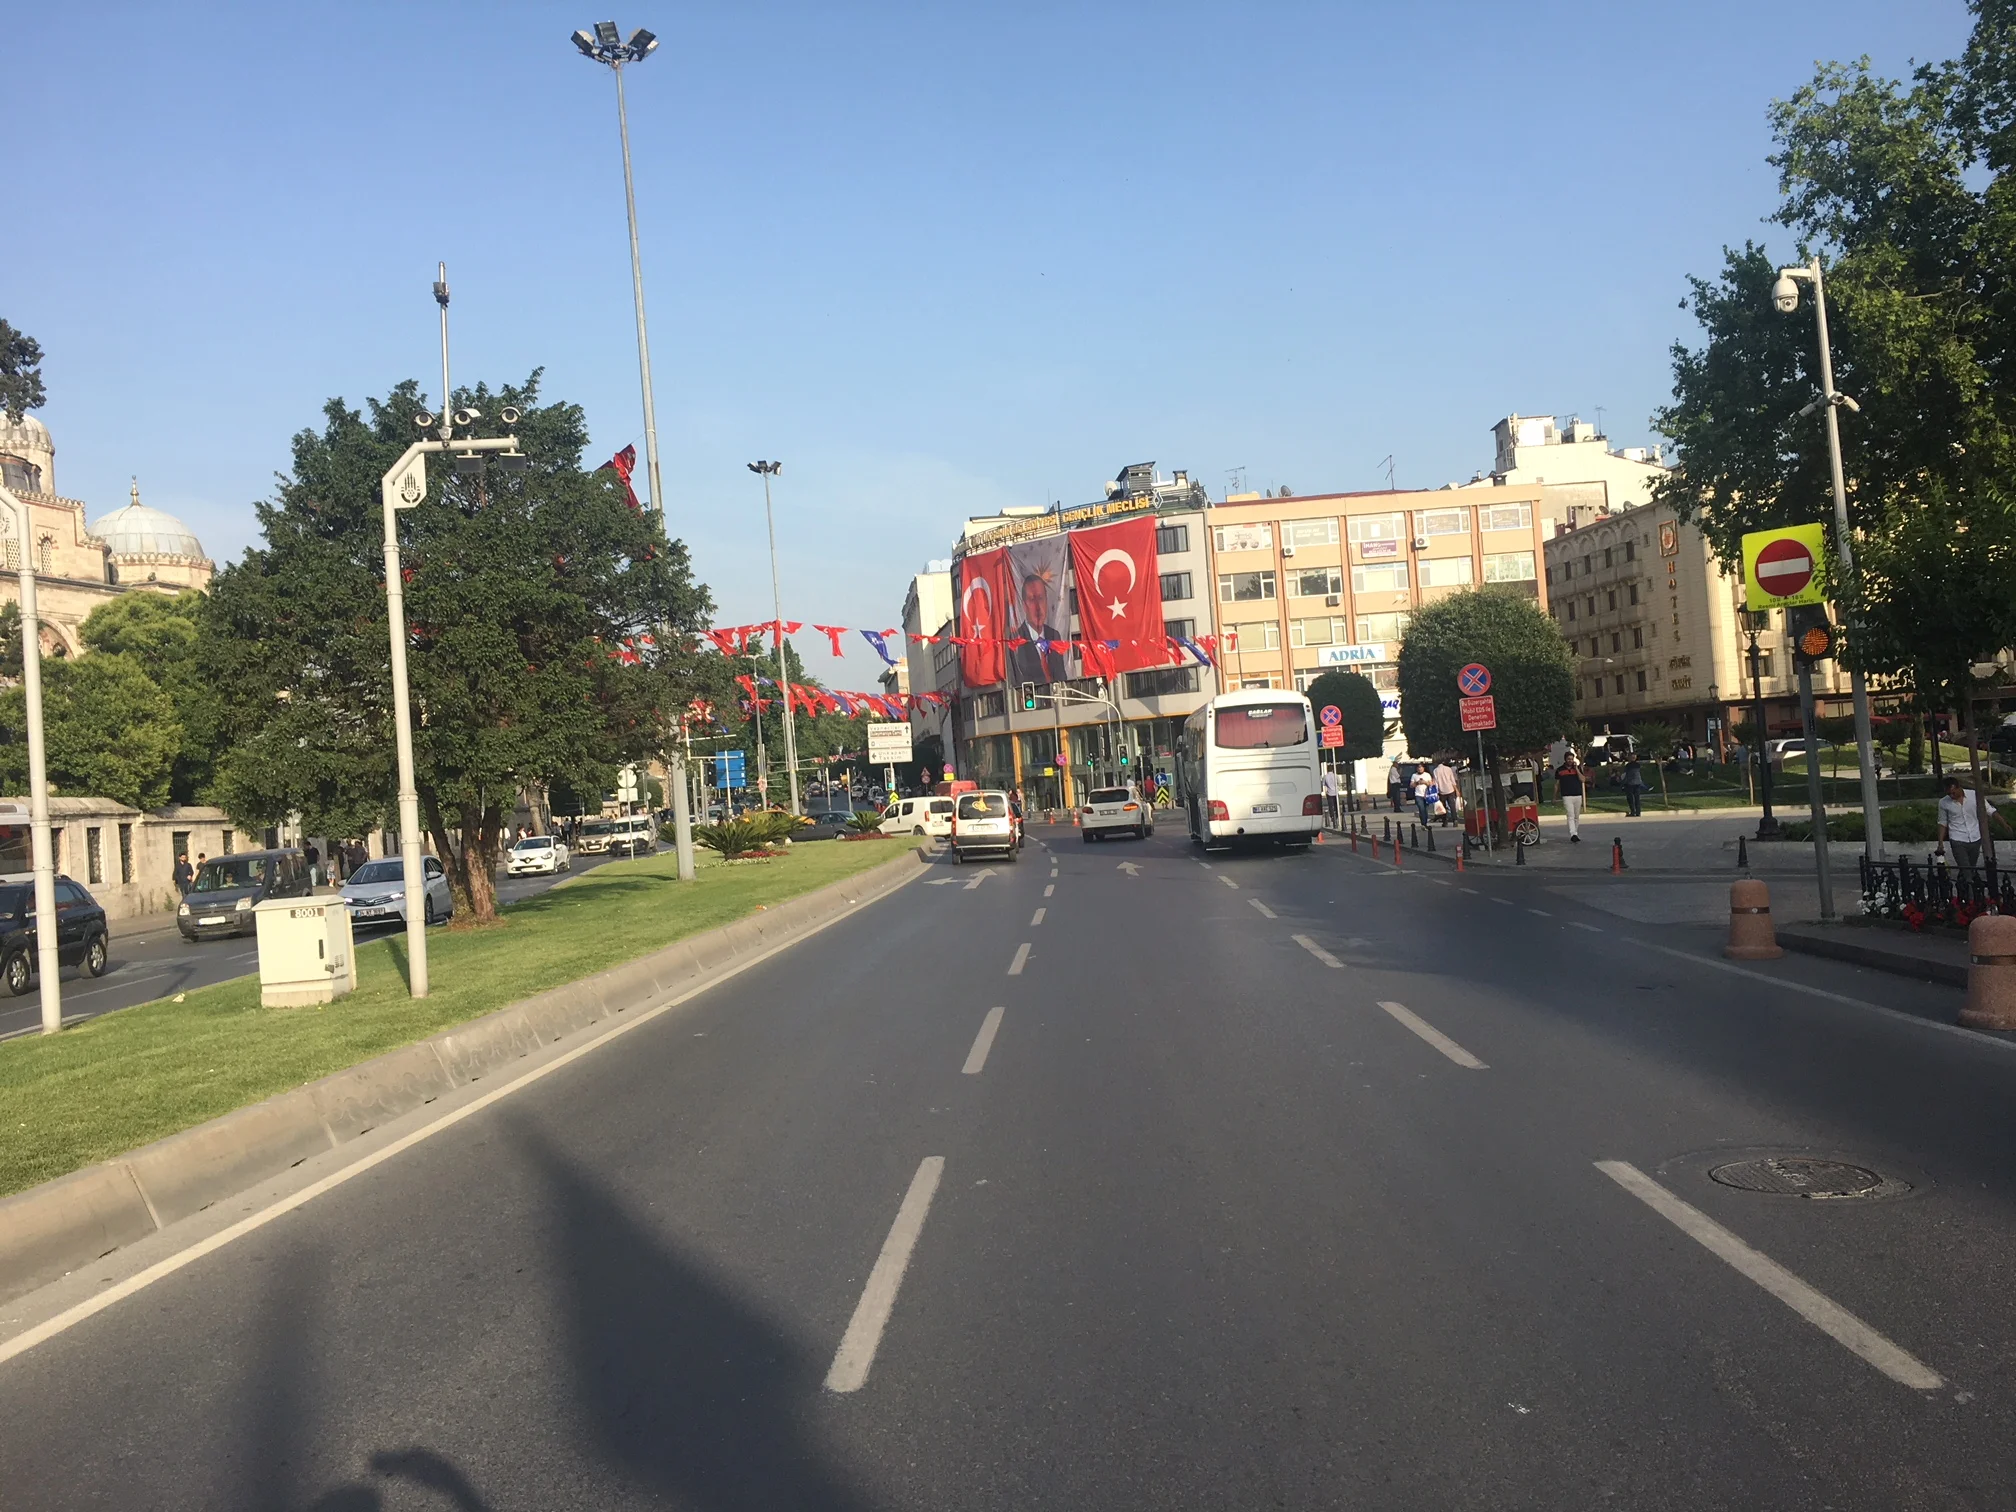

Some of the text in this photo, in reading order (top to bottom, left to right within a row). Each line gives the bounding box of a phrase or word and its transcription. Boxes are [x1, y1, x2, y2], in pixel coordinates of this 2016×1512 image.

[1063, 503, 1106, 523] GENÇLİK
[1106, 495, 1150, 515] MECLİSİ
[1329, 646, 1376, 662] ADRİA
[295, 908, 320, 918] 8001
